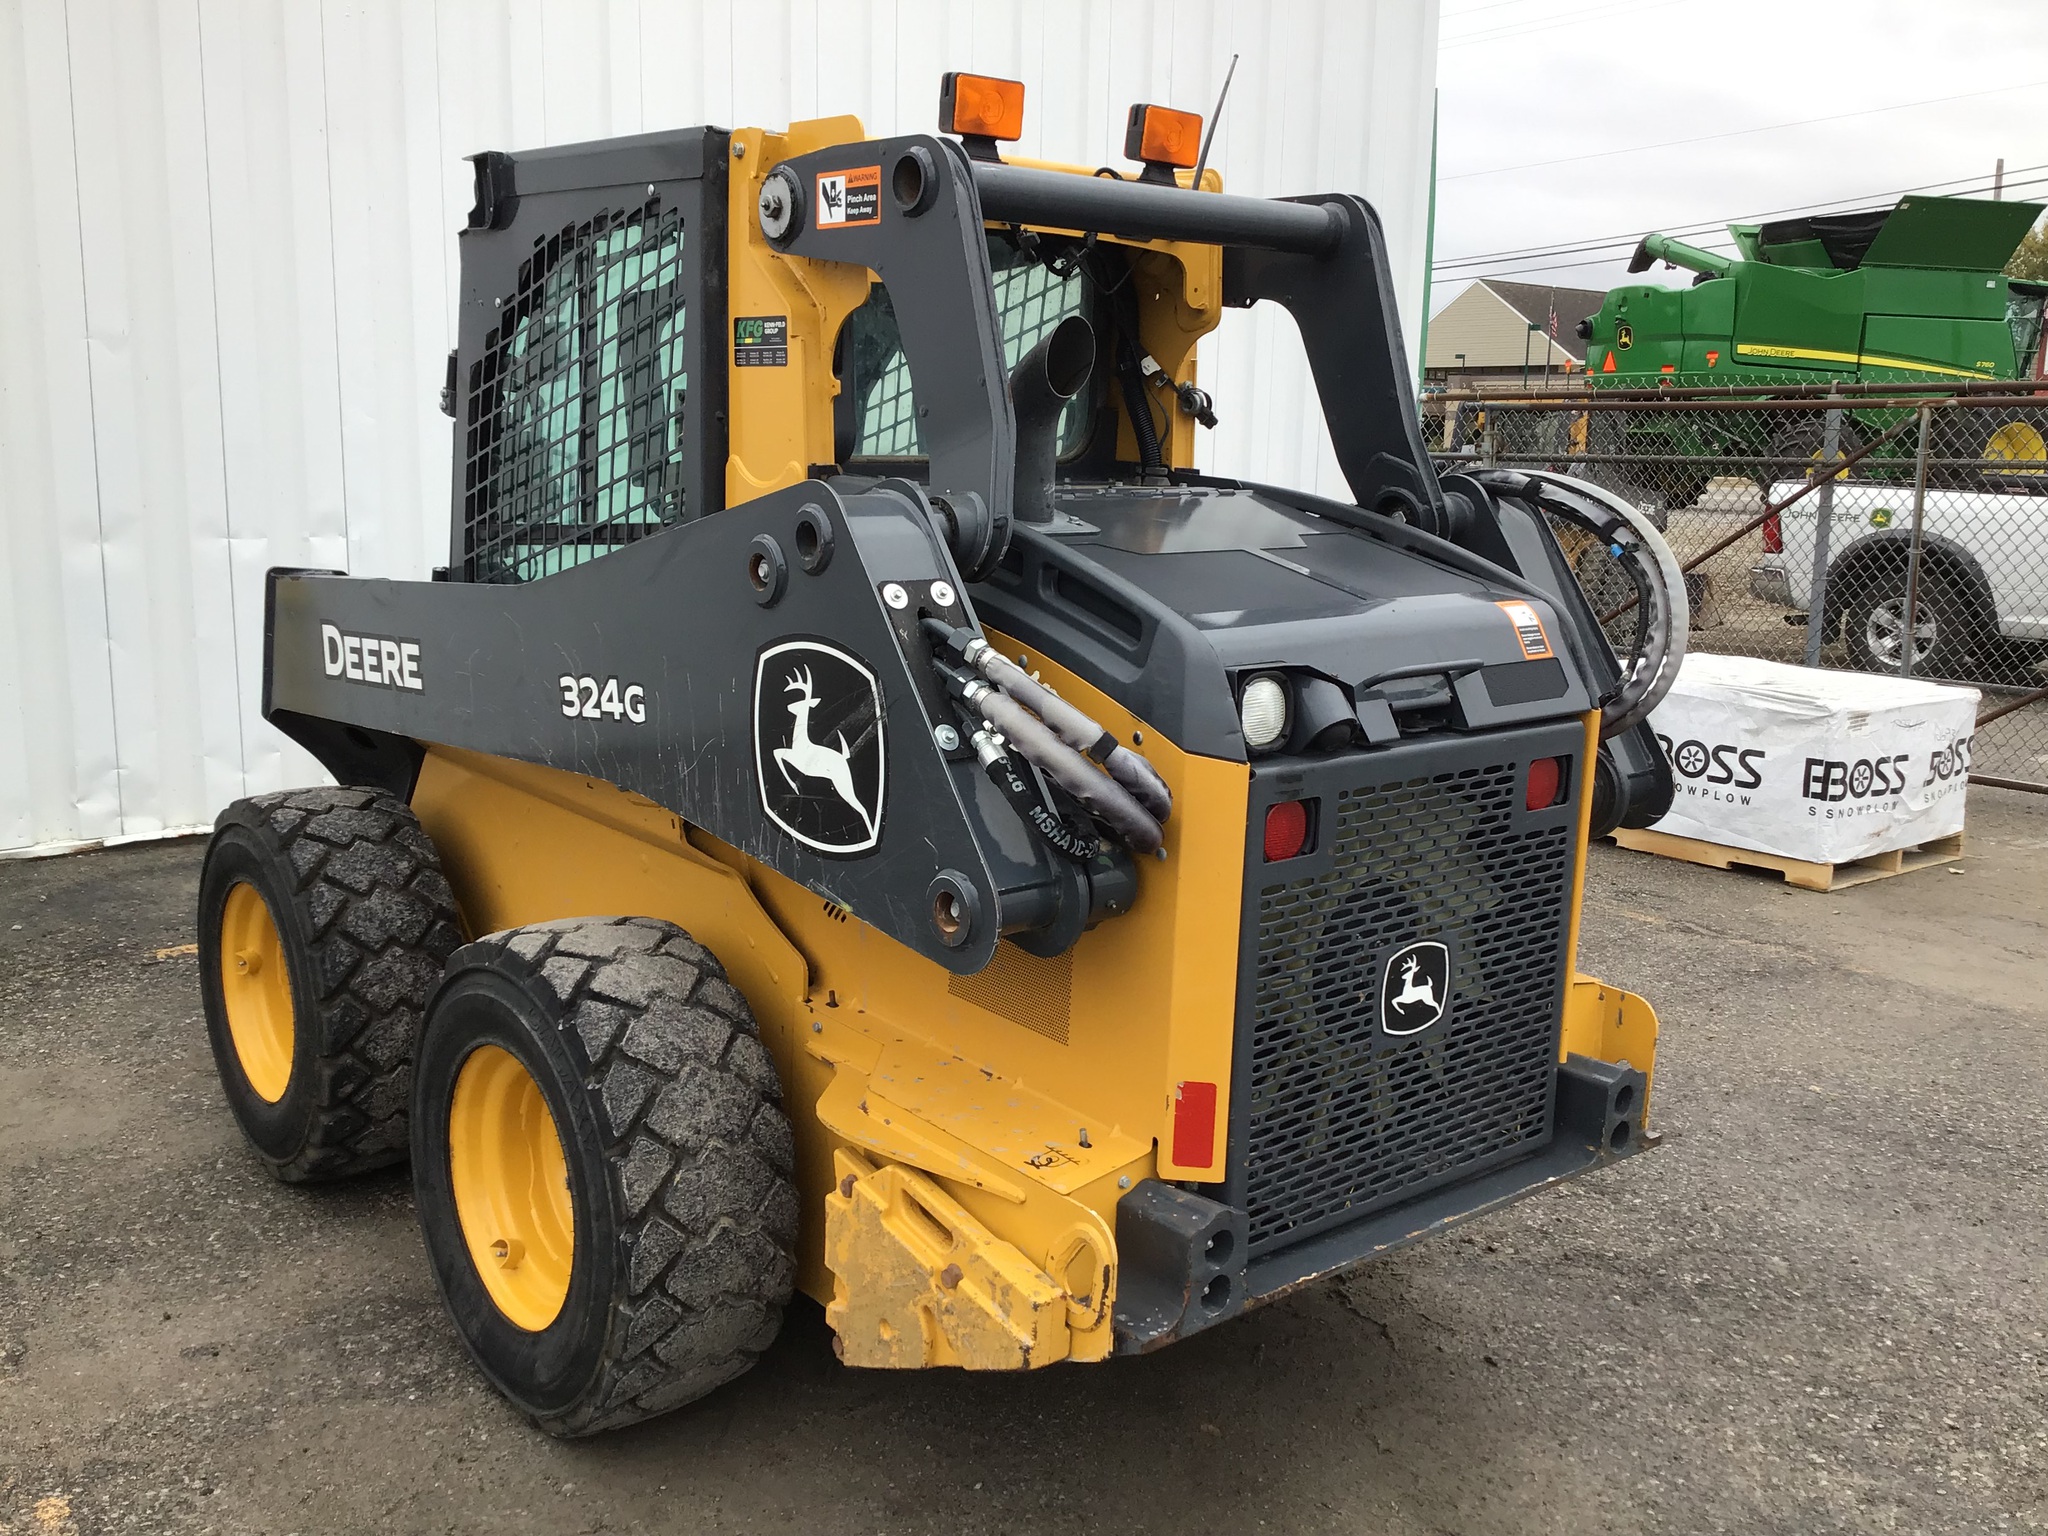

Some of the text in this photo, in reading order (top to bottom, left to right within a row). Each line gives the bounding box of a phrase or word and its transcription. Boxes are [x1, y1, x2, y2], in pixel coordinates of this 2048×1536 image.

[853, 172, 878, 183] WARNING
[847, 193, 877, 204] Pinch Area
[847, 205, 873, 215] Keep Away
[736, 320, 763, 338] KFG
[1748, 347, 1796, 357] JOHN DEERE
[1784, 506, 1861, 523] JOHN EERE
[321, 623, 423, 690] DEERE
[559, 675, 646, 723] 324G
[1028, 805, 1071, 850] MSHA
